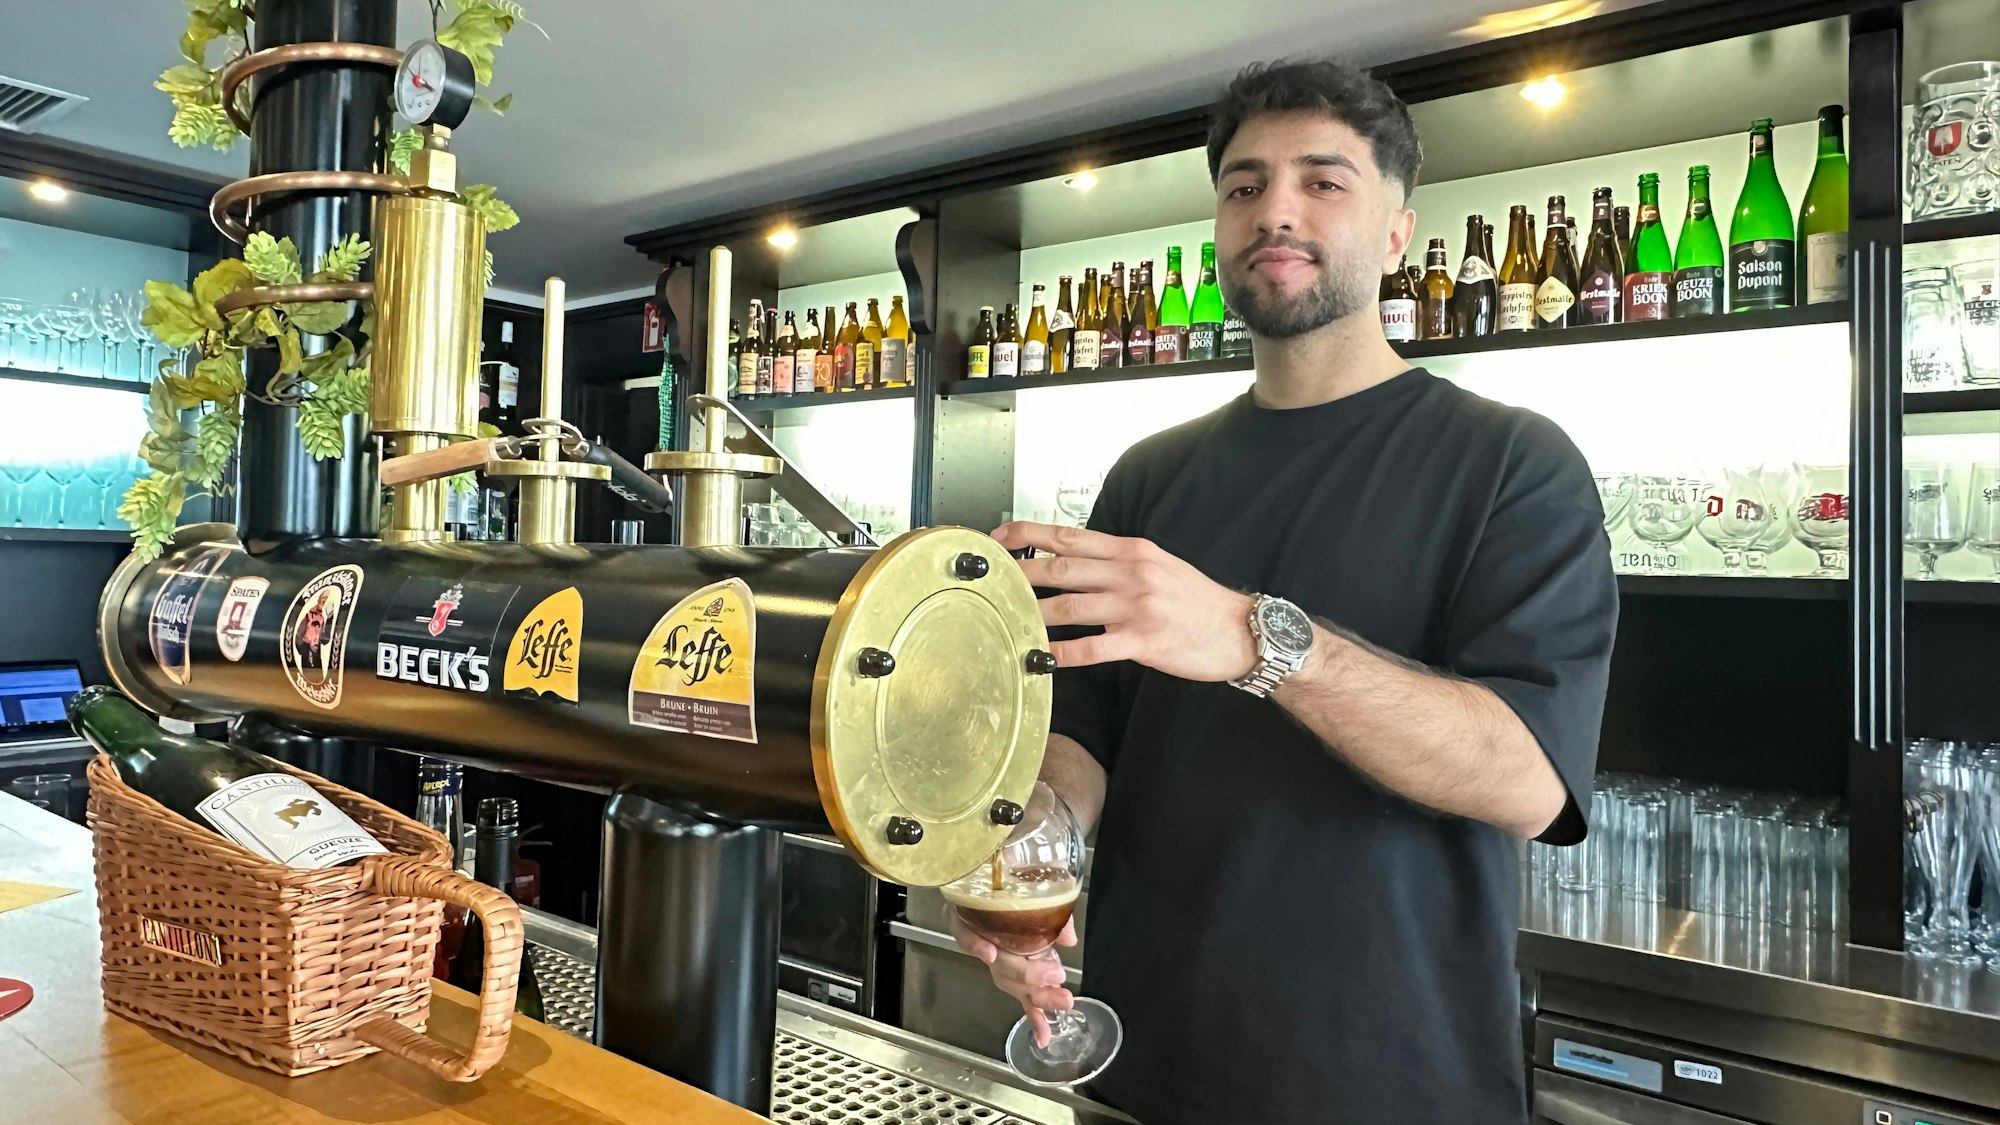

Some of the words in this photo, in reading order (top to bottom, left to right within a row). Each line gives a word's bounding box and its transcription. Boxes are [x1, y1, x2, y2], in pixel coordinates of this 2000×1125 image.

[1738, 259, 1782, 274] Saison
[1676, 278, 1713, 291] GEUZE
[1738, 273, 1782, 289] Dupont
[1633, 283, 1668, 295] KRIEK
[1677, 287, 1713, 302] BOON
[1633, 293, 1668, 305] BOON
[516, 618, 574, 679] Leffe
[655, 625, 734, 687] Leffe
[377, 642, 490, 692] BECK'S
[1696, 1068, 1719, 1080] 1022
